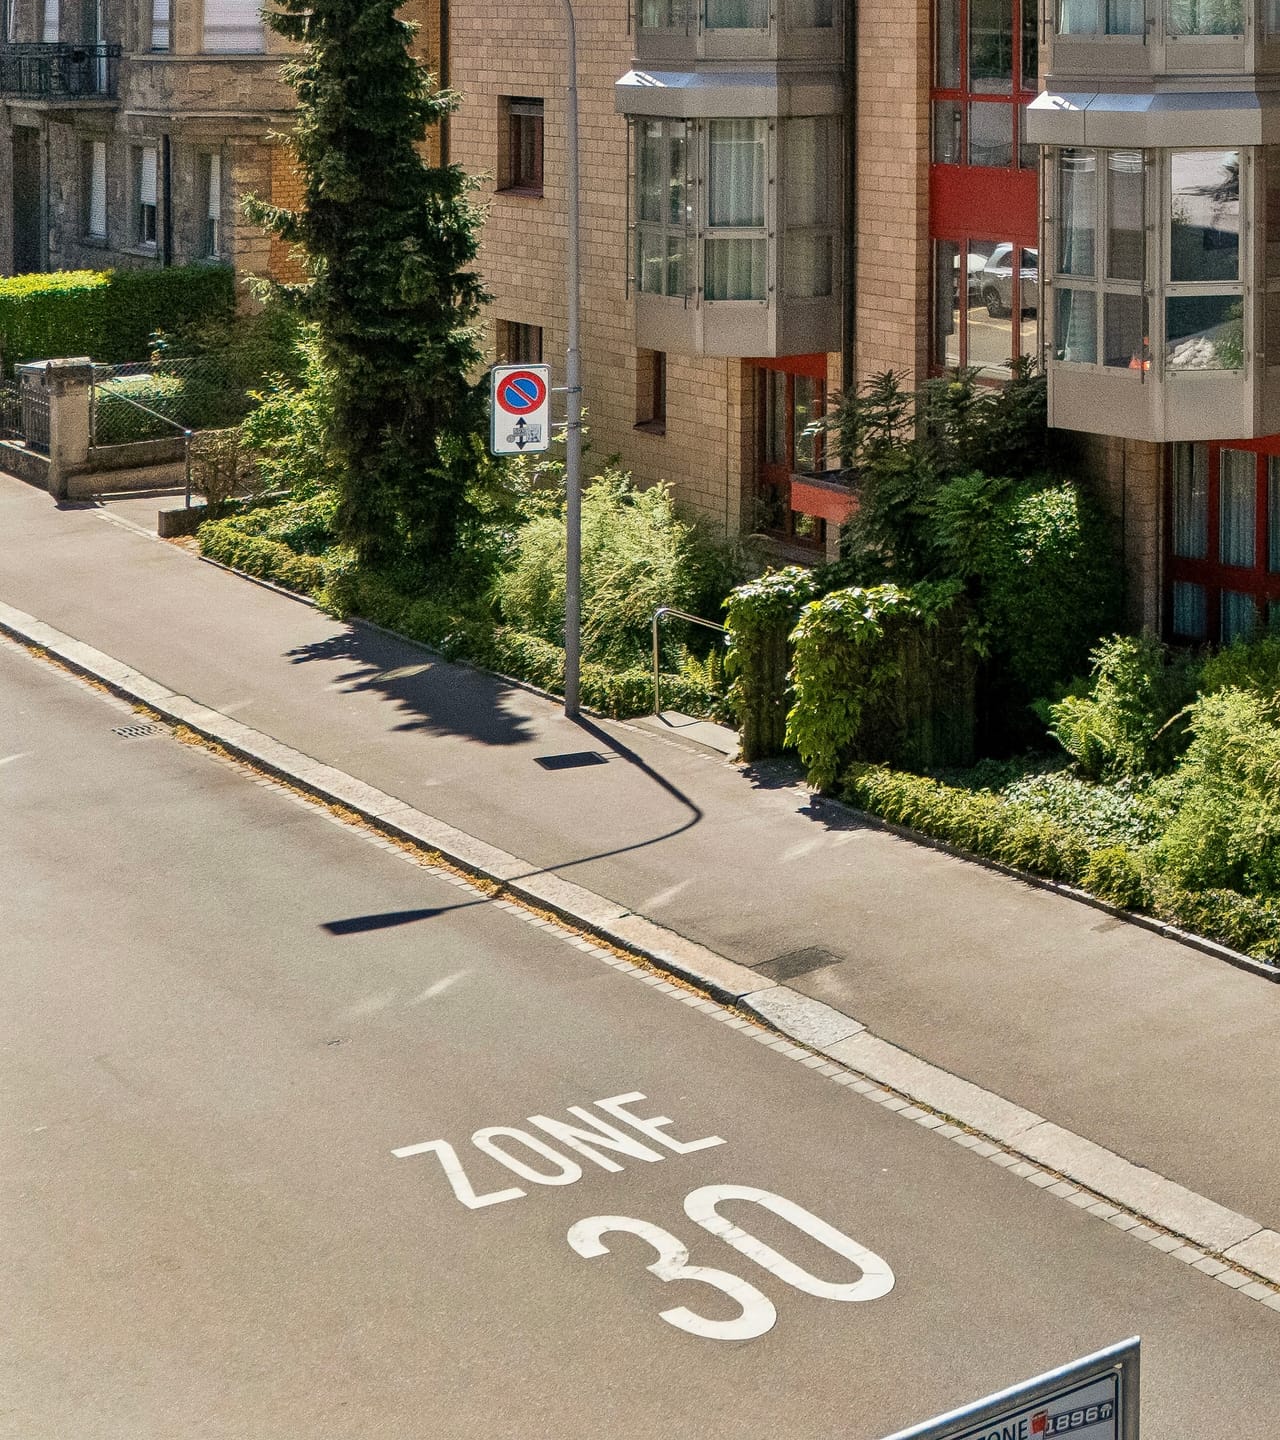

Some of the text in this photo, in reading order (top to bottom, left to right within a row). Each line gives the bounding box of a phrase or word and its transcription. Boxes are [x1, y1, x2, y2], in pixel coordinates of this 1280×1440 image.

[391, 1091, 728, 1210] ZONE
[567, 1184, 896, 1341] 30
[976, 1418, 1029, 1440] NE
[1046, 1407, 1097, 1434] 1896
